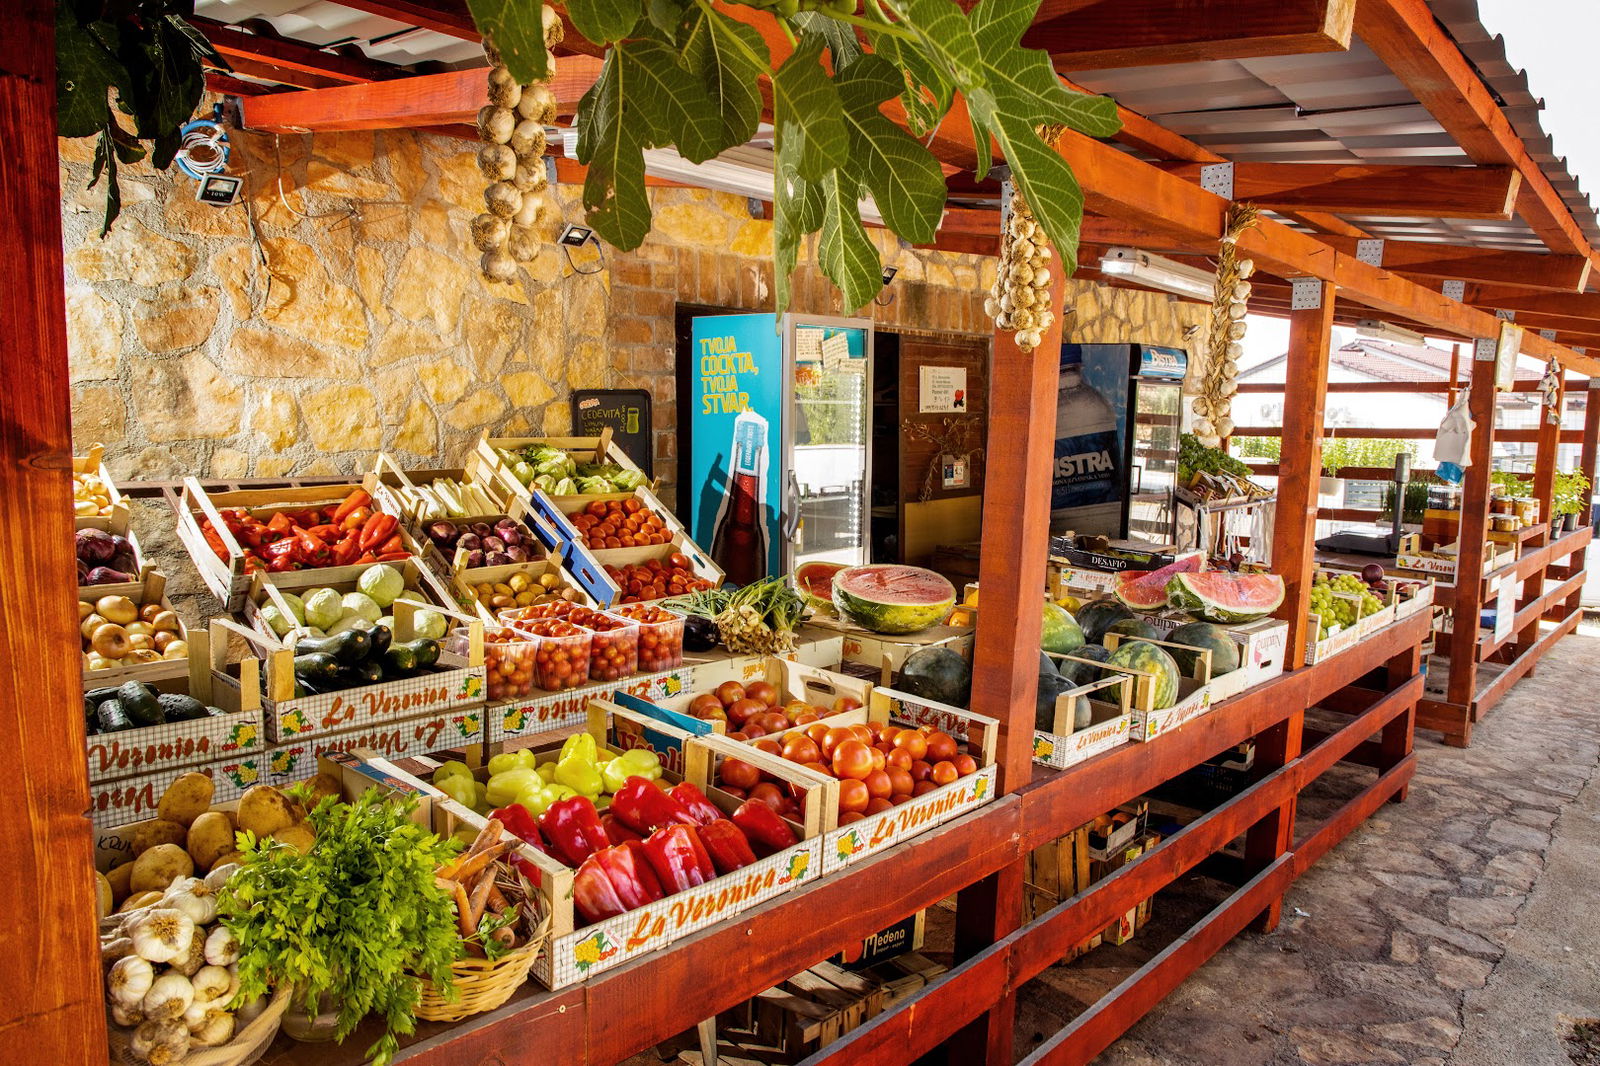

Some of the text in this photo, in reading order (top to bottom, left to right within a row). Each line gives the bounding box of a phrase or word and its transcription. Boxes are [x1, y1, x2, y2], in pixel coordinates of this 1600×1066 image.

[699, 335, 737, 355] TVOJA
[700, 352, 759, 376] COCKTA,
[700, 377, 738, 393] TVOJA
[702, 392, 754, 415] STVAR.
[1054, 450, 1115, 478] ISTRA
[322, 686, 448, 729] La Veronica
[538, 691, 614, 723] onica
[414, 718, 445, 749] La
[88, 735, 210, 773] Veronica
[869, 787, 966, 849] La Veronica
[625, 868, 776, 951] La Veronica
[863, 928, 905, 959] Medena
